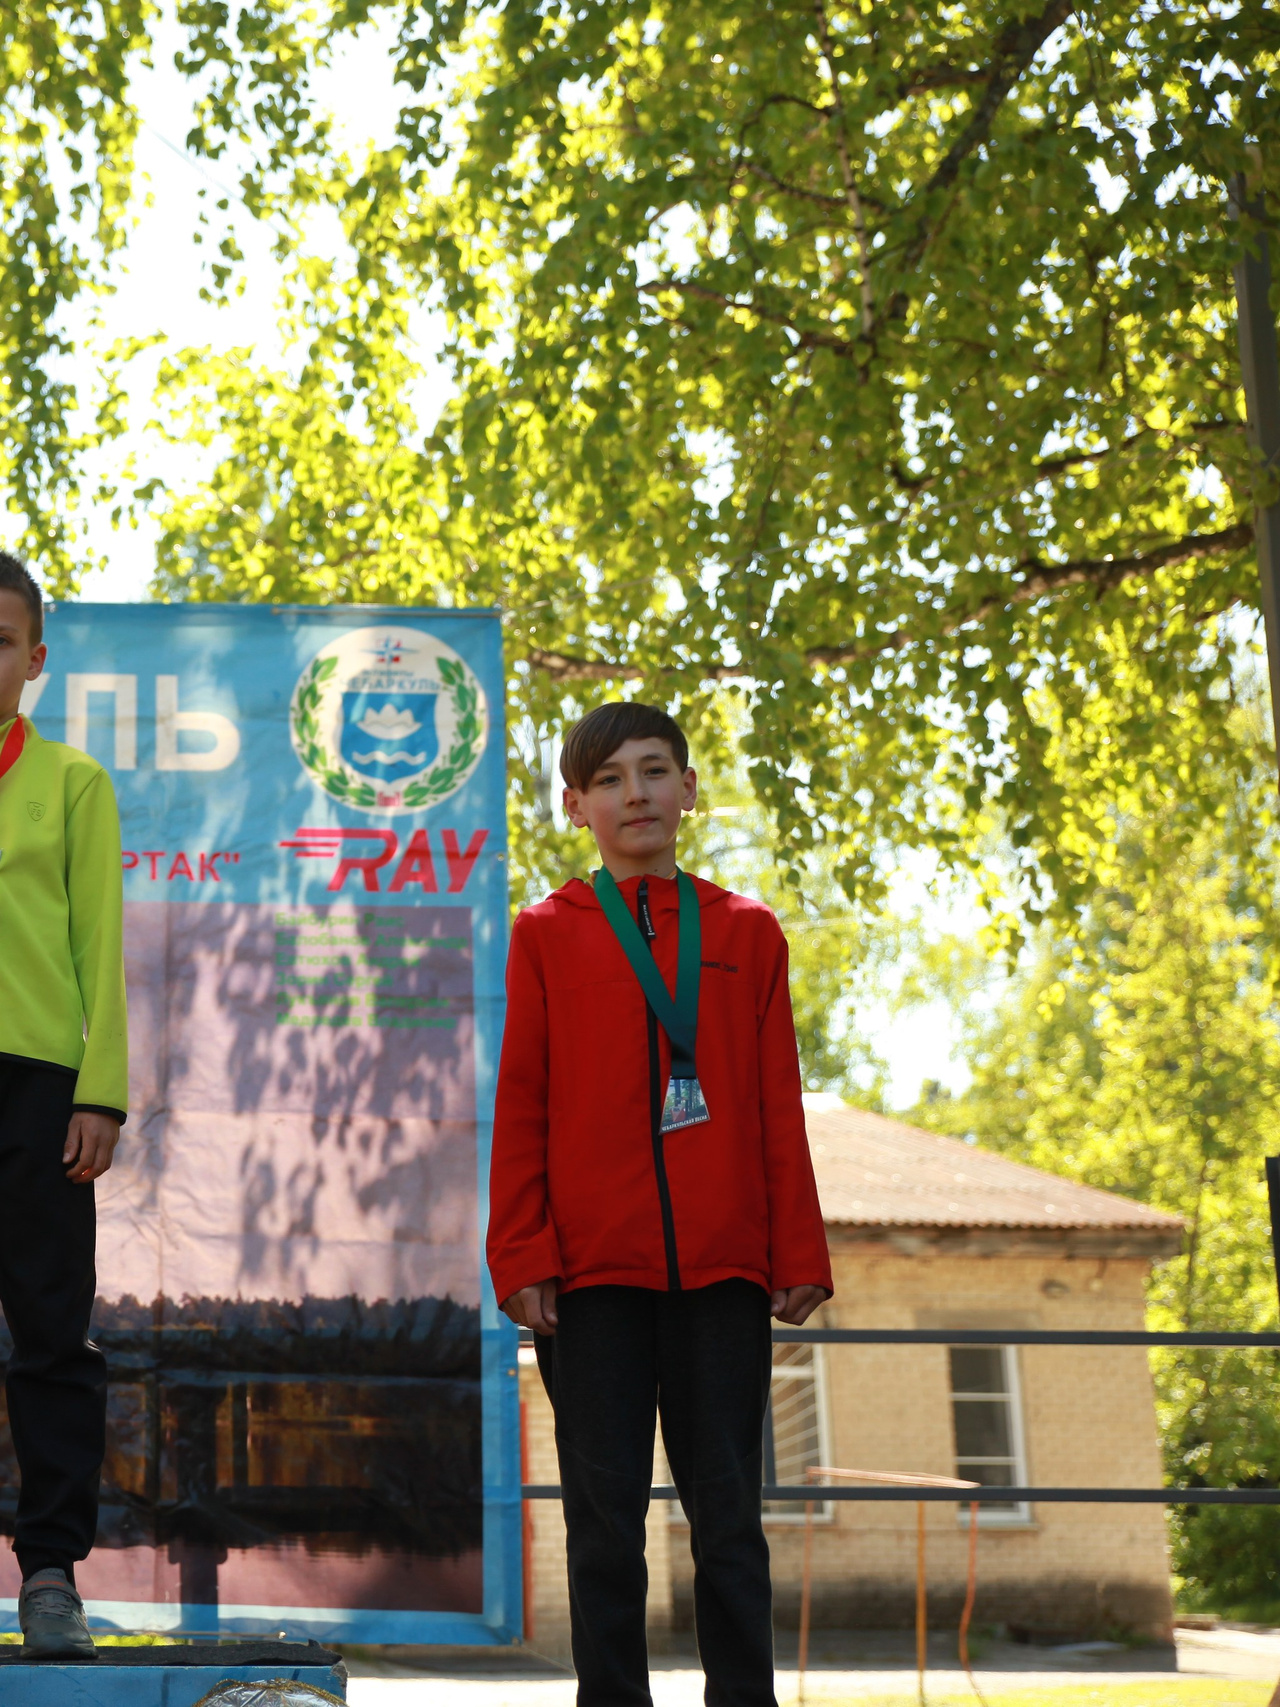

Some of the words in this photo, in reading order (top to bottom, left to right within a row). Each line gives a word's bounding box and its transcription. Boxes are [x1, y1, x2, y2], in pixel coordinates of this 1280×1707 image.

[122, 850, 240, 883] РТАК"
[278, 827, 490, 894] RAY
[367, 1012, 457, 1030] Владимир
